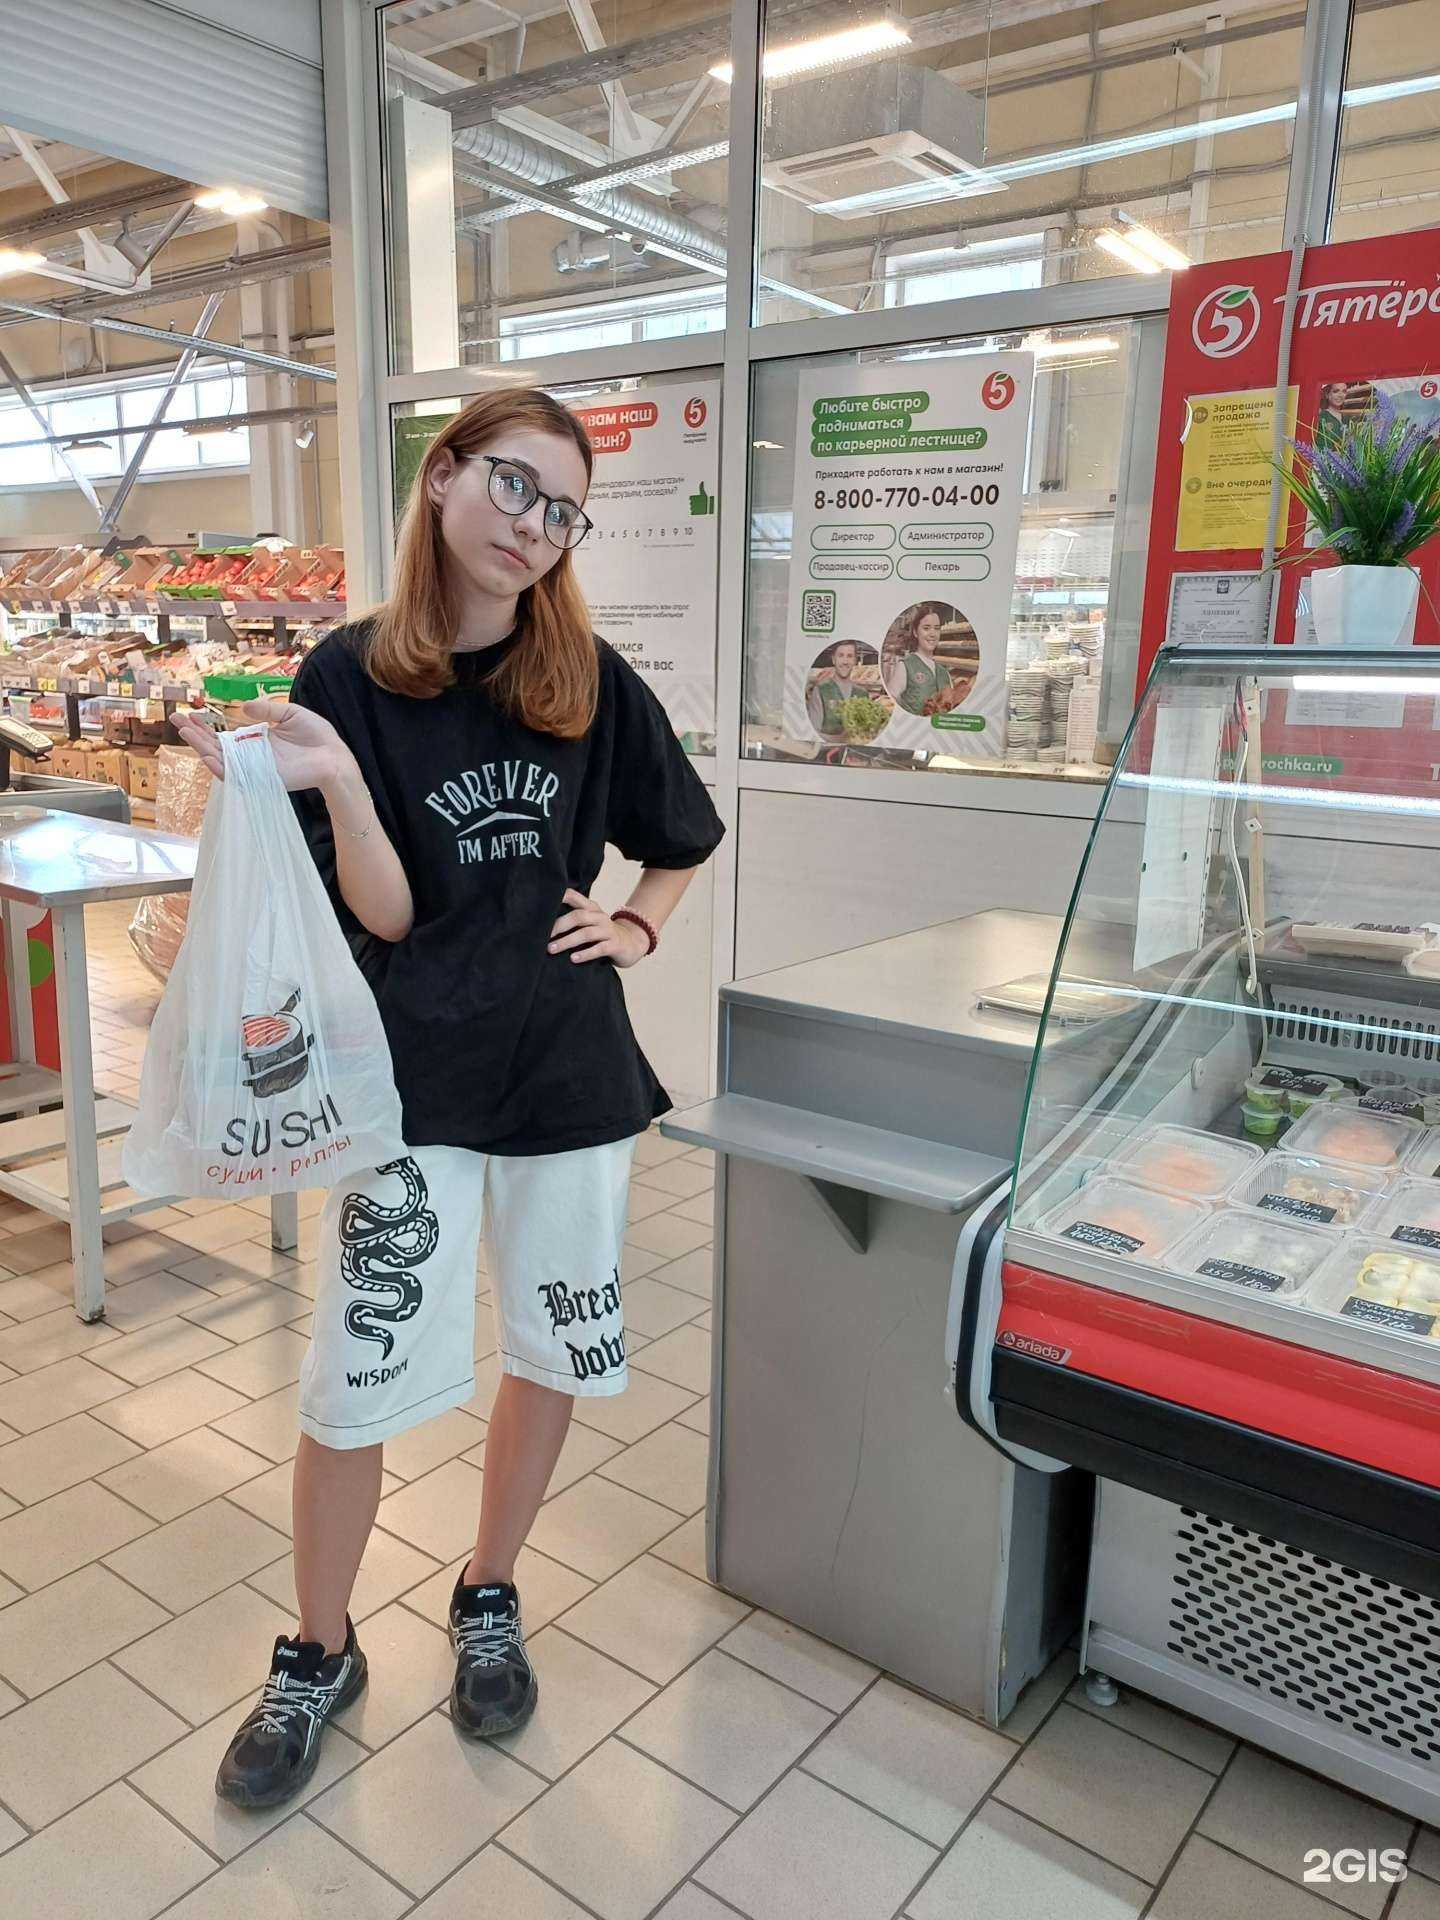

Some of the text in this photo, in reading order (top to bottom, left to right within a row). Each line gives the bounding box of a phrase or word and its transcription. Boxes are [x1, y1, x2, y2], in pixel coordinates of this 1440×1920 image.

[818, 396, 922, 415] Любите быстро
[1213, 400, 1275, 413] Запрещена
[588, 414, 617, 428] вам
[620, 408, 653, 425] наш
[818, 417, 905, 433] подниматься
[1212, 411, 1261, 423] продажа
[590, 430, 627, 449] зин?
[817, 430, 982, 453] по карьерной лестнице?
[815, 463, 1005, 480] Приходите работать к нам в магазин!
[1206, 477, 1273, 490] Вне очереди
[814, 484, 1000, 510] 8-800-770-04-00
[830, 532, 875, 544] Директор
[907, 529, 985, 542] Администратор
[813, 561, 889, 573] Продавец-кассир
[924, 561, 961, 573] Пекарь
[630, 657, 675, 671] для вас
[425, 760, 560, 827] FOREVER
[457, 830, 543, 864] I'M AFTER
[221, 1093, 343, 1158] SUSHI
[207, 1163, 264, 1185] суши
[537, 1263, 622, 1337] Brea
[564, 1326, 625, 1382] dow
[1016, 1338, 1060, 1360] ariada
[346, 1358, 409, 1388] WISDOM
